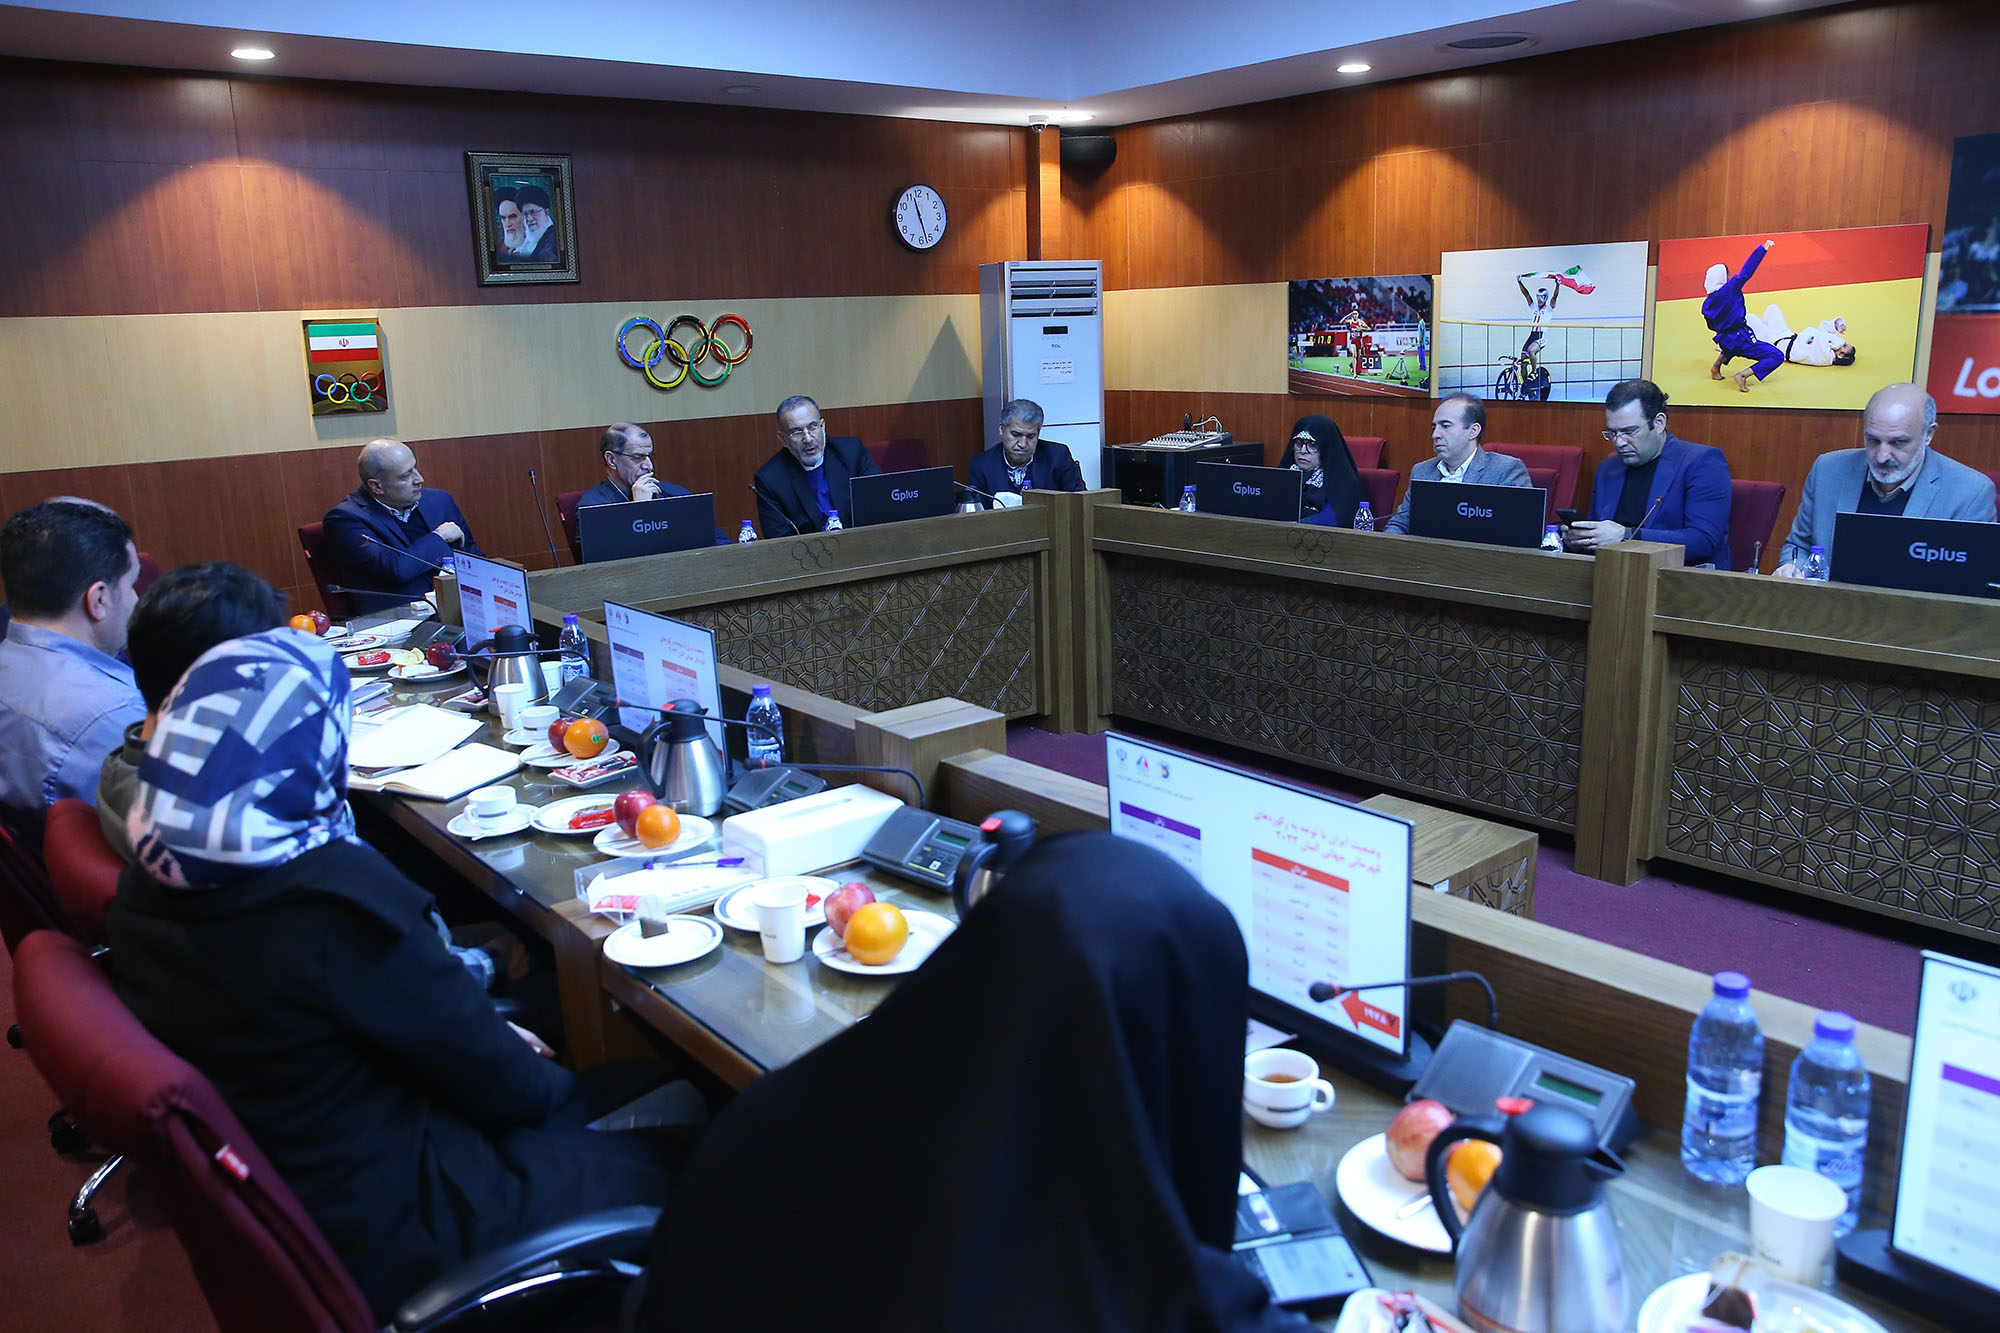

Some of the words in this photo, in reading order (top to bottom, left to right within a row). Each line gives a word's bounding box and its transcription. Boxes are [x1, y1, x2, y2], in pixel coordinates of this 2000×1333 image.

[914, 189, 922, 198] 12
[900, 202, 907, 210] 10
[932, 201, 937, 209] 2
[898, 214, 903, 222] 9
[936, 212, 941, 221] 3
[902, 226, 908, 234] 8
[934, 224, 939, 232] 4
[918, 236, 924, 244] 6
[928, 233, 933, 241] 5
[1232, 481, 1261, 496] Gplus
[890, 488, 919, 502] Gplus
[1457, 502, 1493, 518] Gplus
[632, 519, 669, 533] Gplus
[1908, 541, 1968, 562] Gplus
